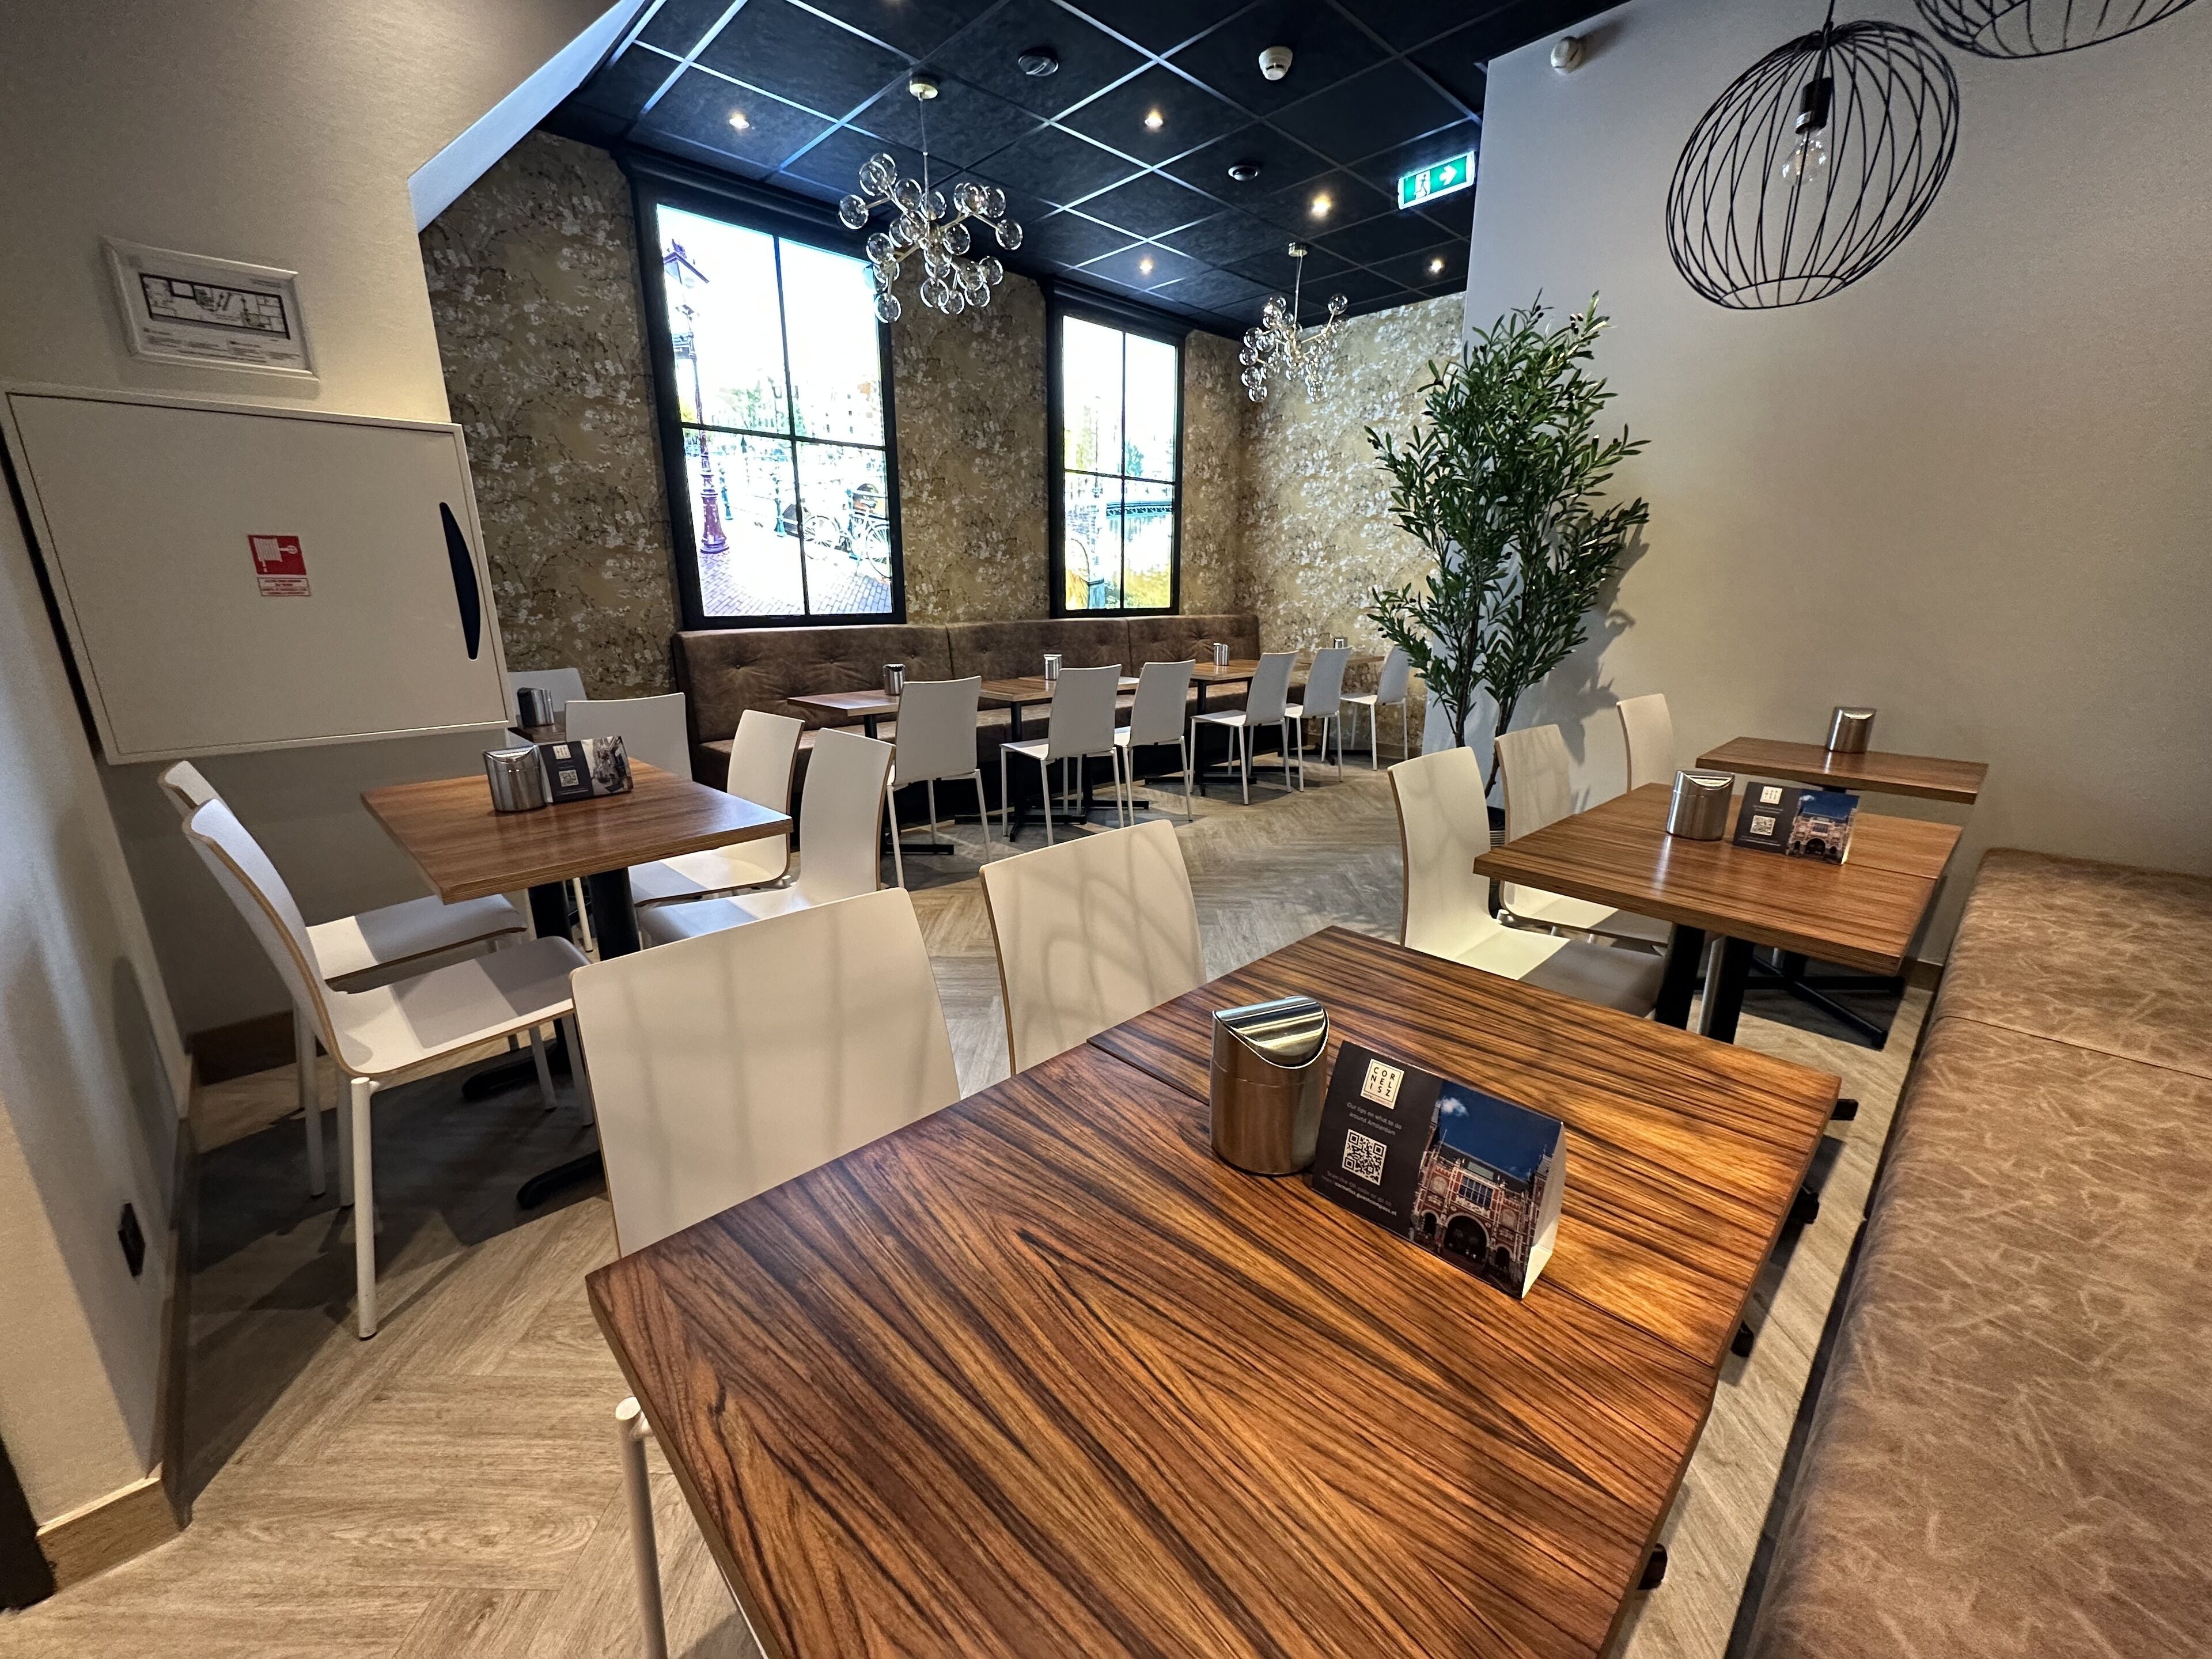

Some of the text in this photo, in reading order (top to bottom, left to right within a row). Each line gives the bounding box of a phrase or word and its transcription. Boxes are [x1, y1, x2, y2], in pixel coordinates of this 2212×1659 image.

[1349, 1112, 1396, 1135] around Amsterdam
[1374, 1115, 1387, 1123] what
